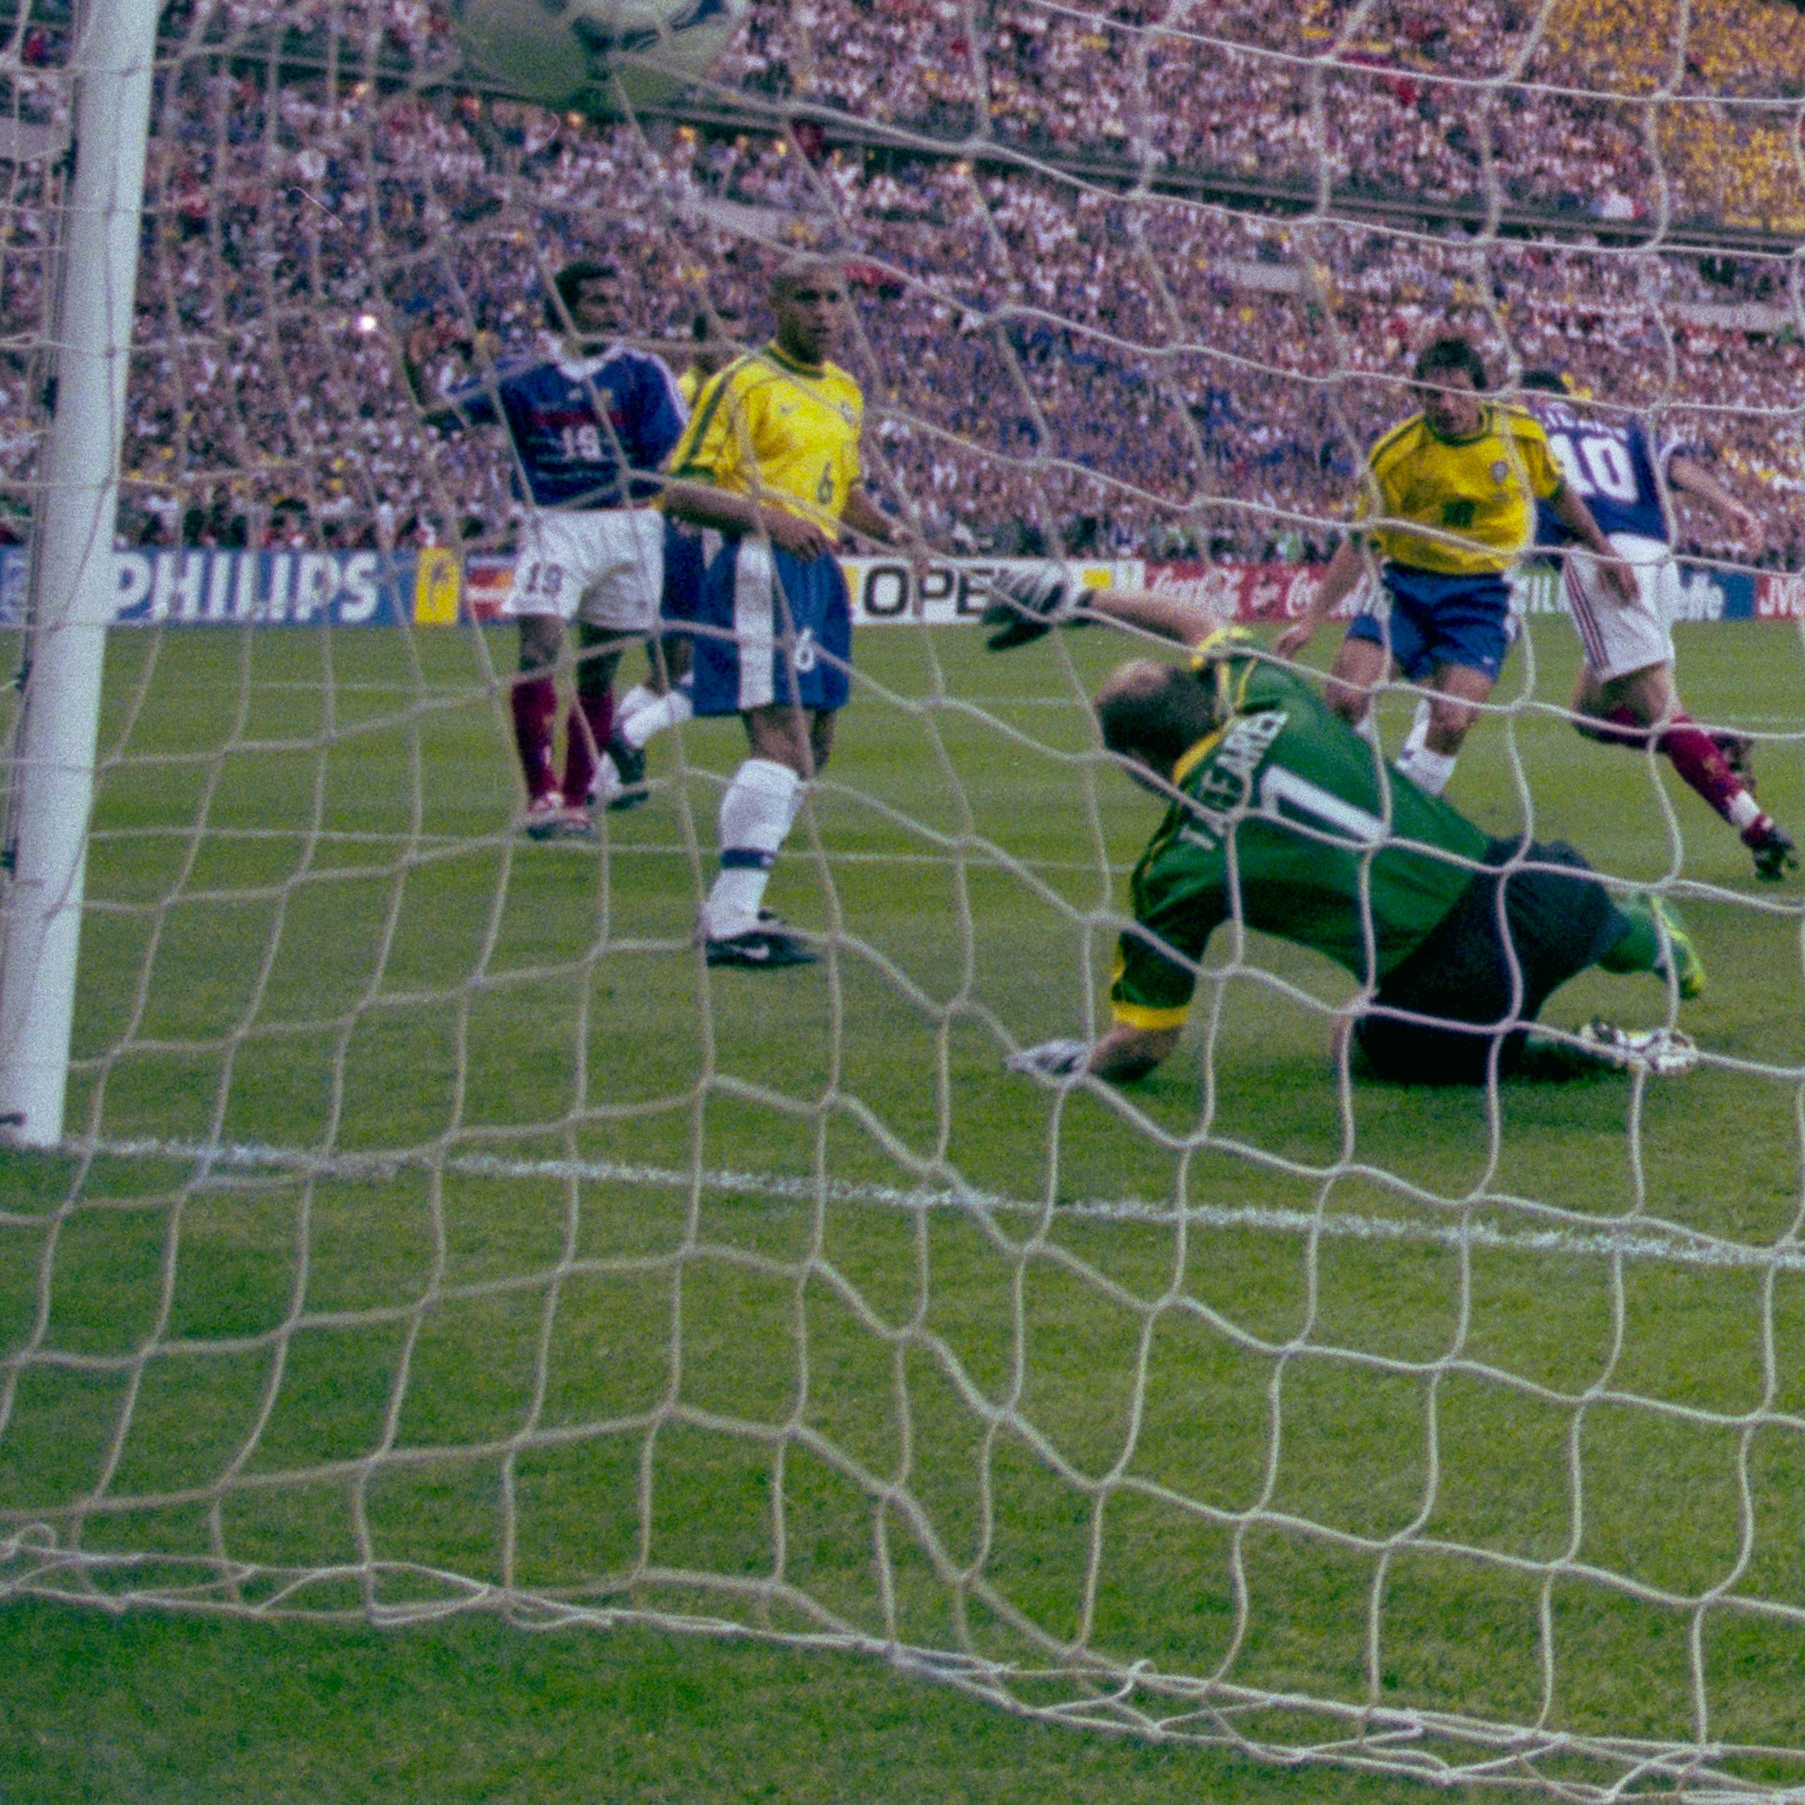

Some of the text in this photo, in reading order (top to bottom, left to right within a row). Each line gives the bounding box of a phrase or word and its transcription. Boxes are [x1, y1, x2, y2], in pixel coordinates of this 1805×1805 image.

[816, 460, 836, 506] 6
[1550, 433, 1638, 502] 10
[110, 551, 378, 621] PHILIPS
[863, 564, 1010, 617] OPE
[793, 627, 816, 673] 6
